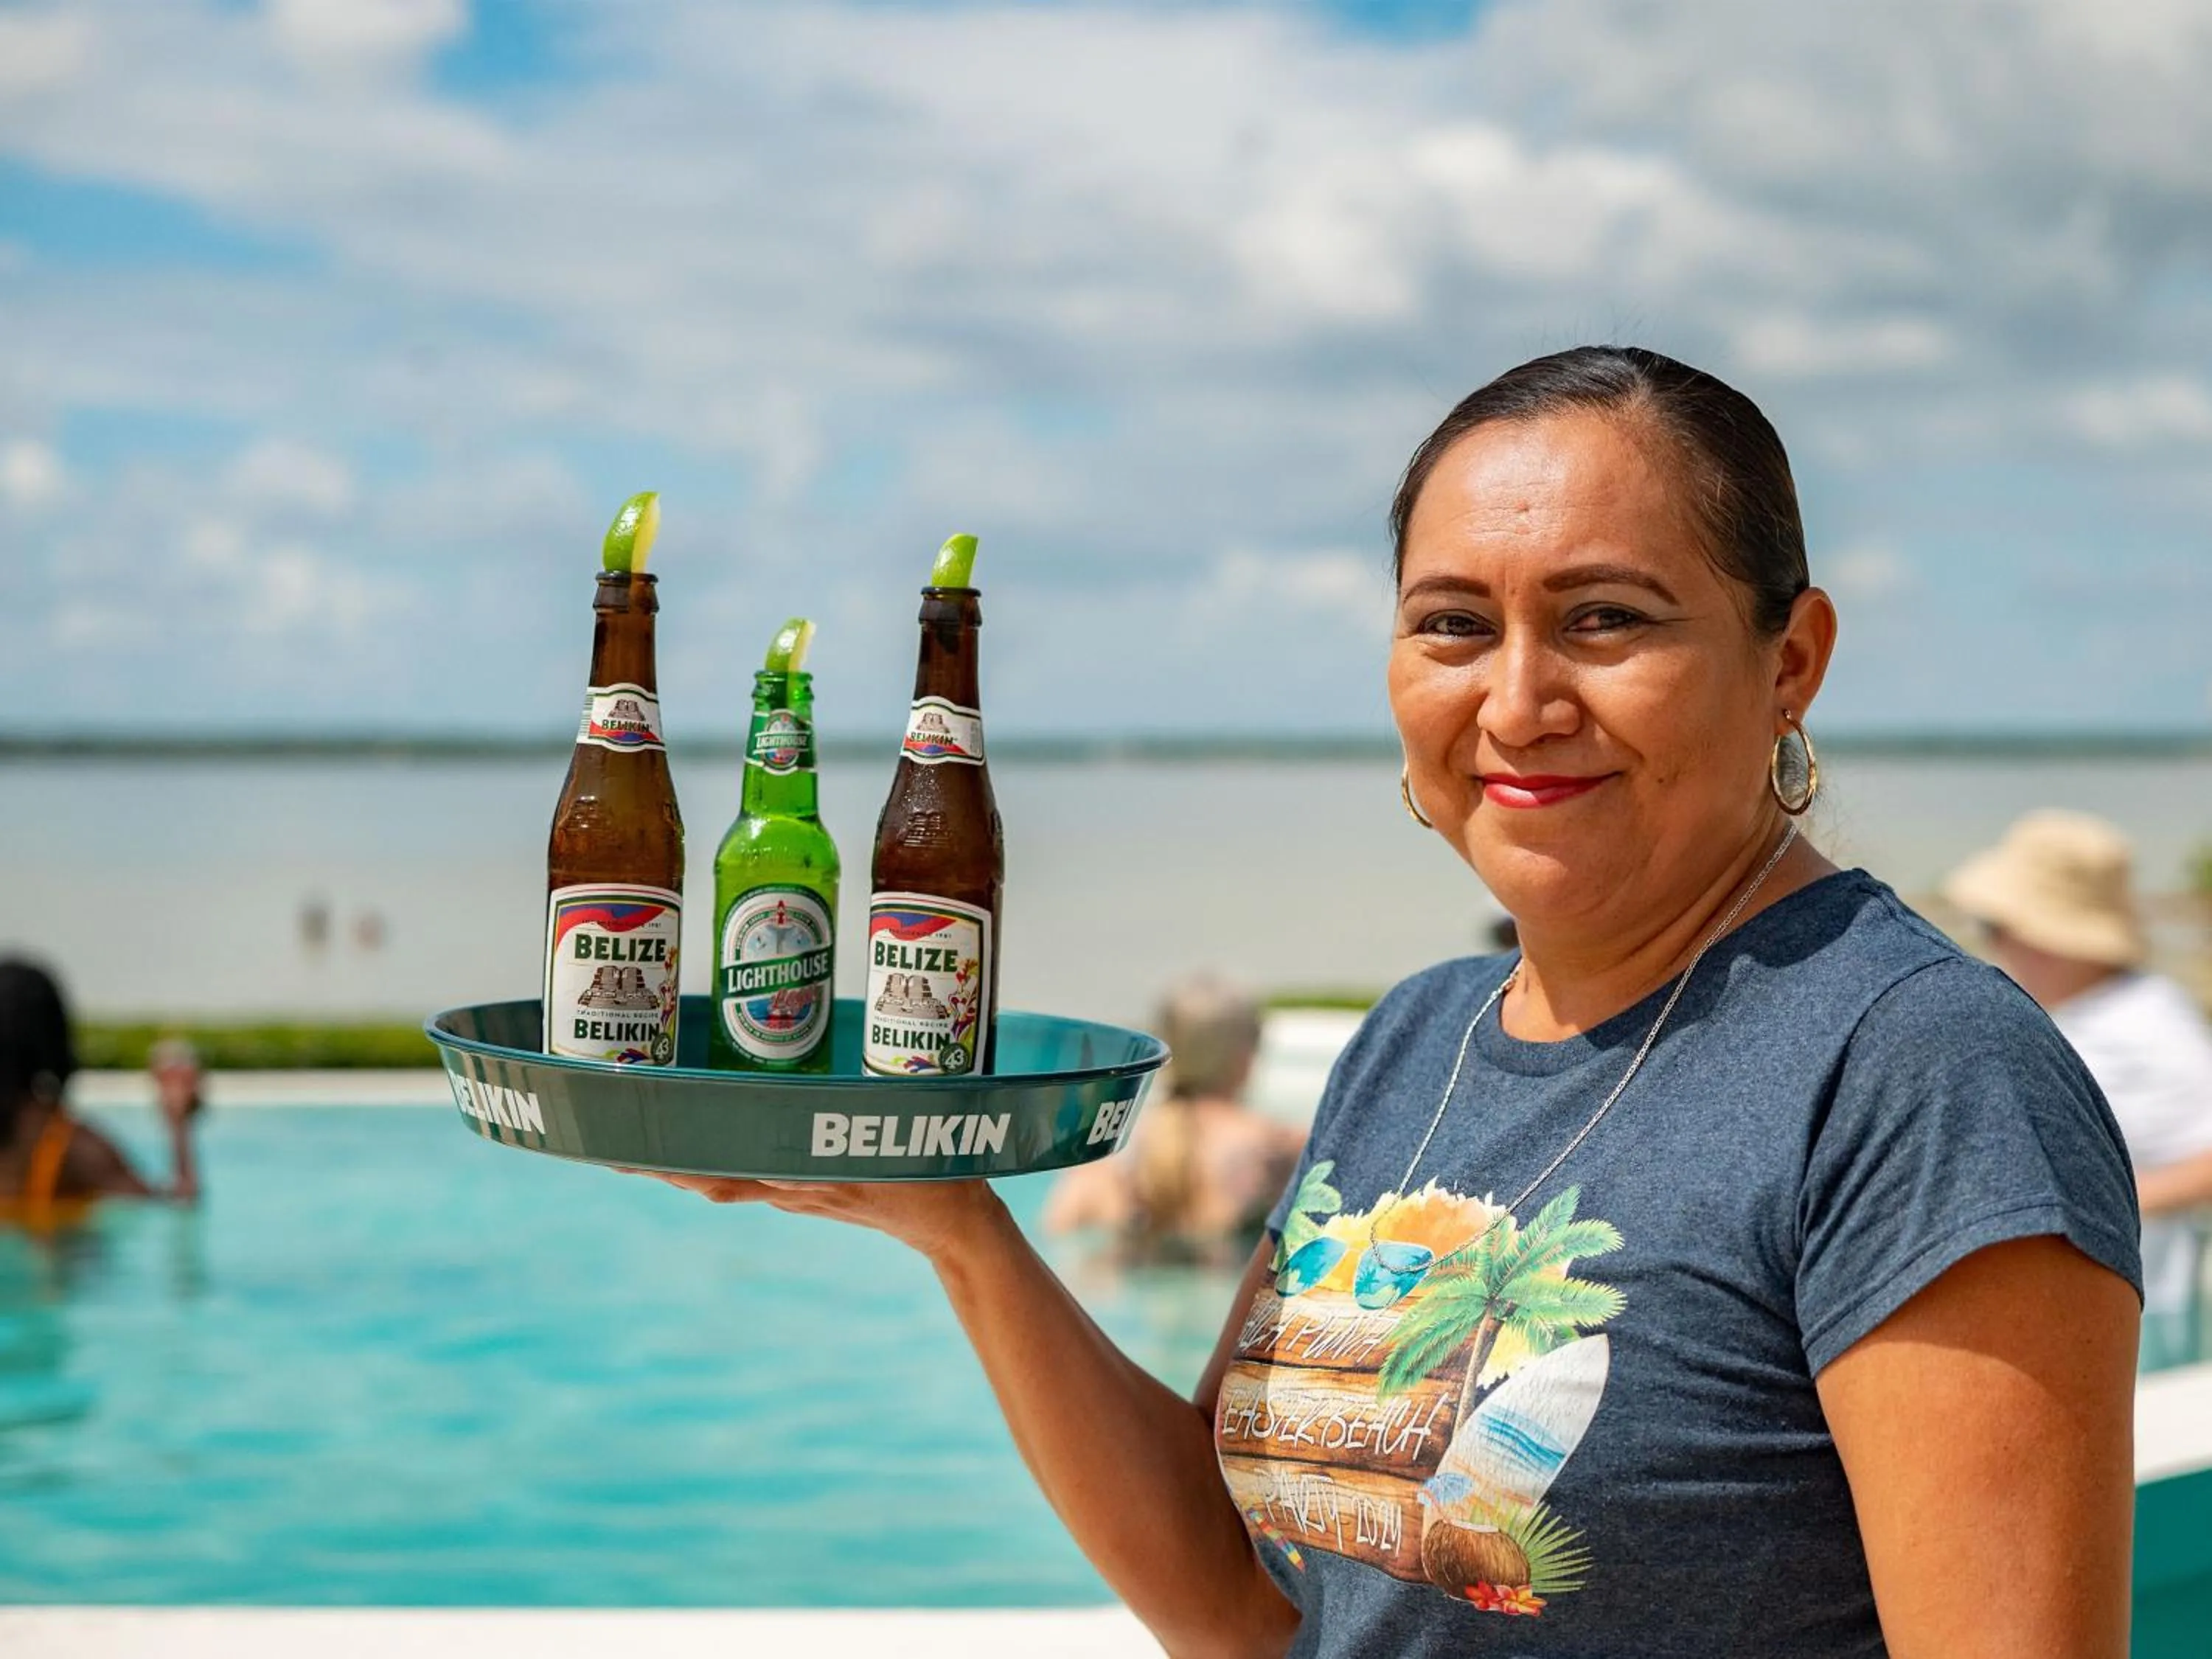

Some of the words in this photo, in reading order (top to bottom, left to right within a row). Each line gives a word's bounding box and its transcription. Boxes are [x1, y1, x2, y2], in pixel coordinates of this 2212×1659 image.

[602, 719, 650, 732] BELIKIN
[909, 732, 954, 746] BELIKIN
[574, 933, 667, 962] BELIZE
[874, 940, 959, 973] BELIZE
[728, 952, 830, 994] LIGHTHOUSE
[574, 1018, 660, 1042] BELIKIN
[872, 1024, 950, 1051] BELIKIN
[810, 1112, 1012, 1157] BELIKIN
[1222, 1388, 1329, 1449] EASTER
[1320, 1392, 1450, 1461] BEACH
[1350, 1494, 1402, 1558] 2024
